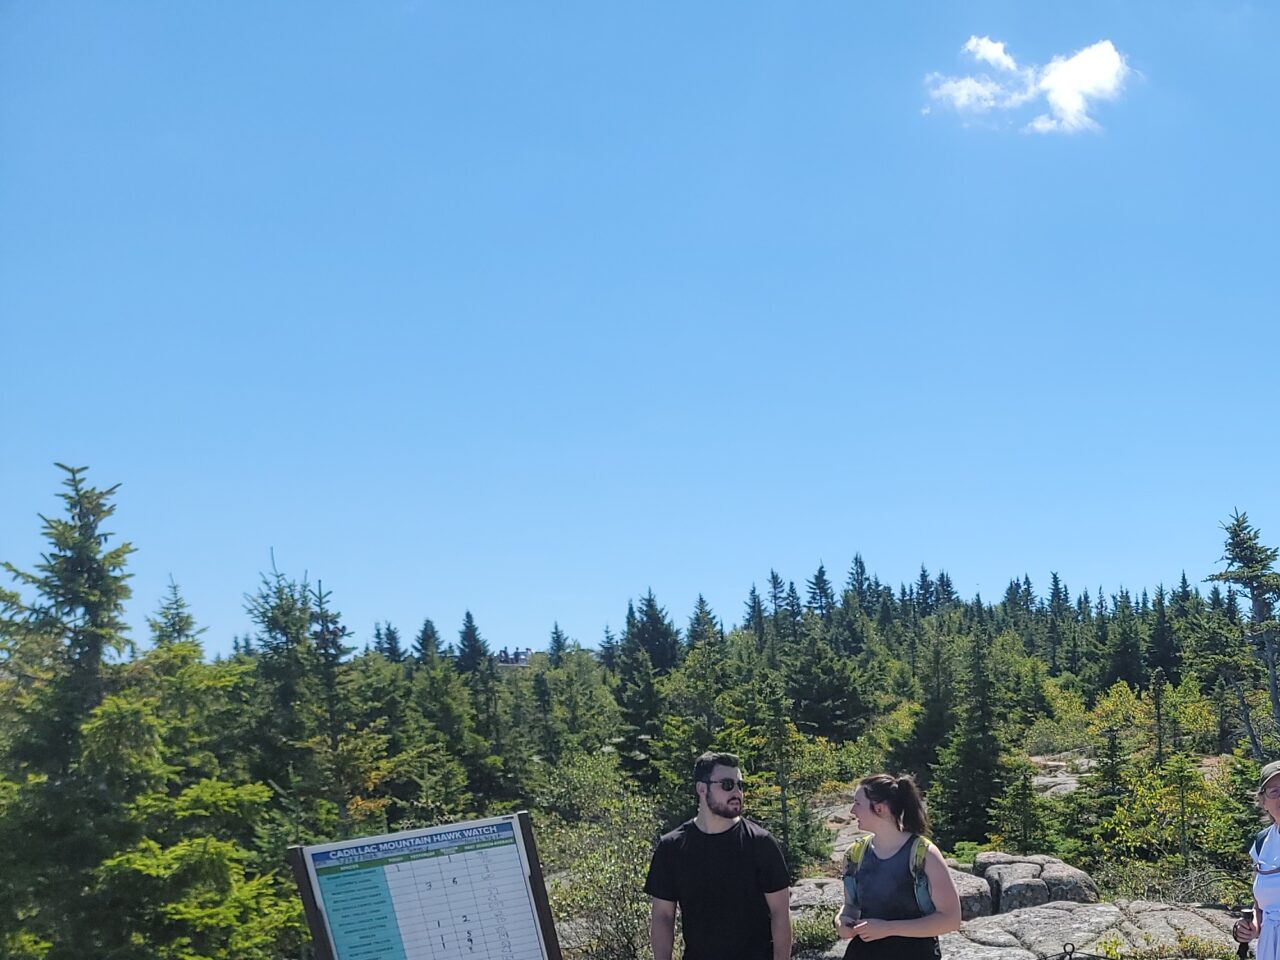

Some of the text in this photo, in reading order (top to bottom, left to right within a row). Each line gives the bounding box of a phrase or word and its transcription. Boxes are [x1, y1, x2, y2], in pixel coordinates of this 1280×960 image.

[329, 844, 378, 860] CADILLAC
[379, 835, 432, 851] MOUNTAIN
[432, 831, 462, 843] HAWK
[462, 825, 498, 837] WATCH
